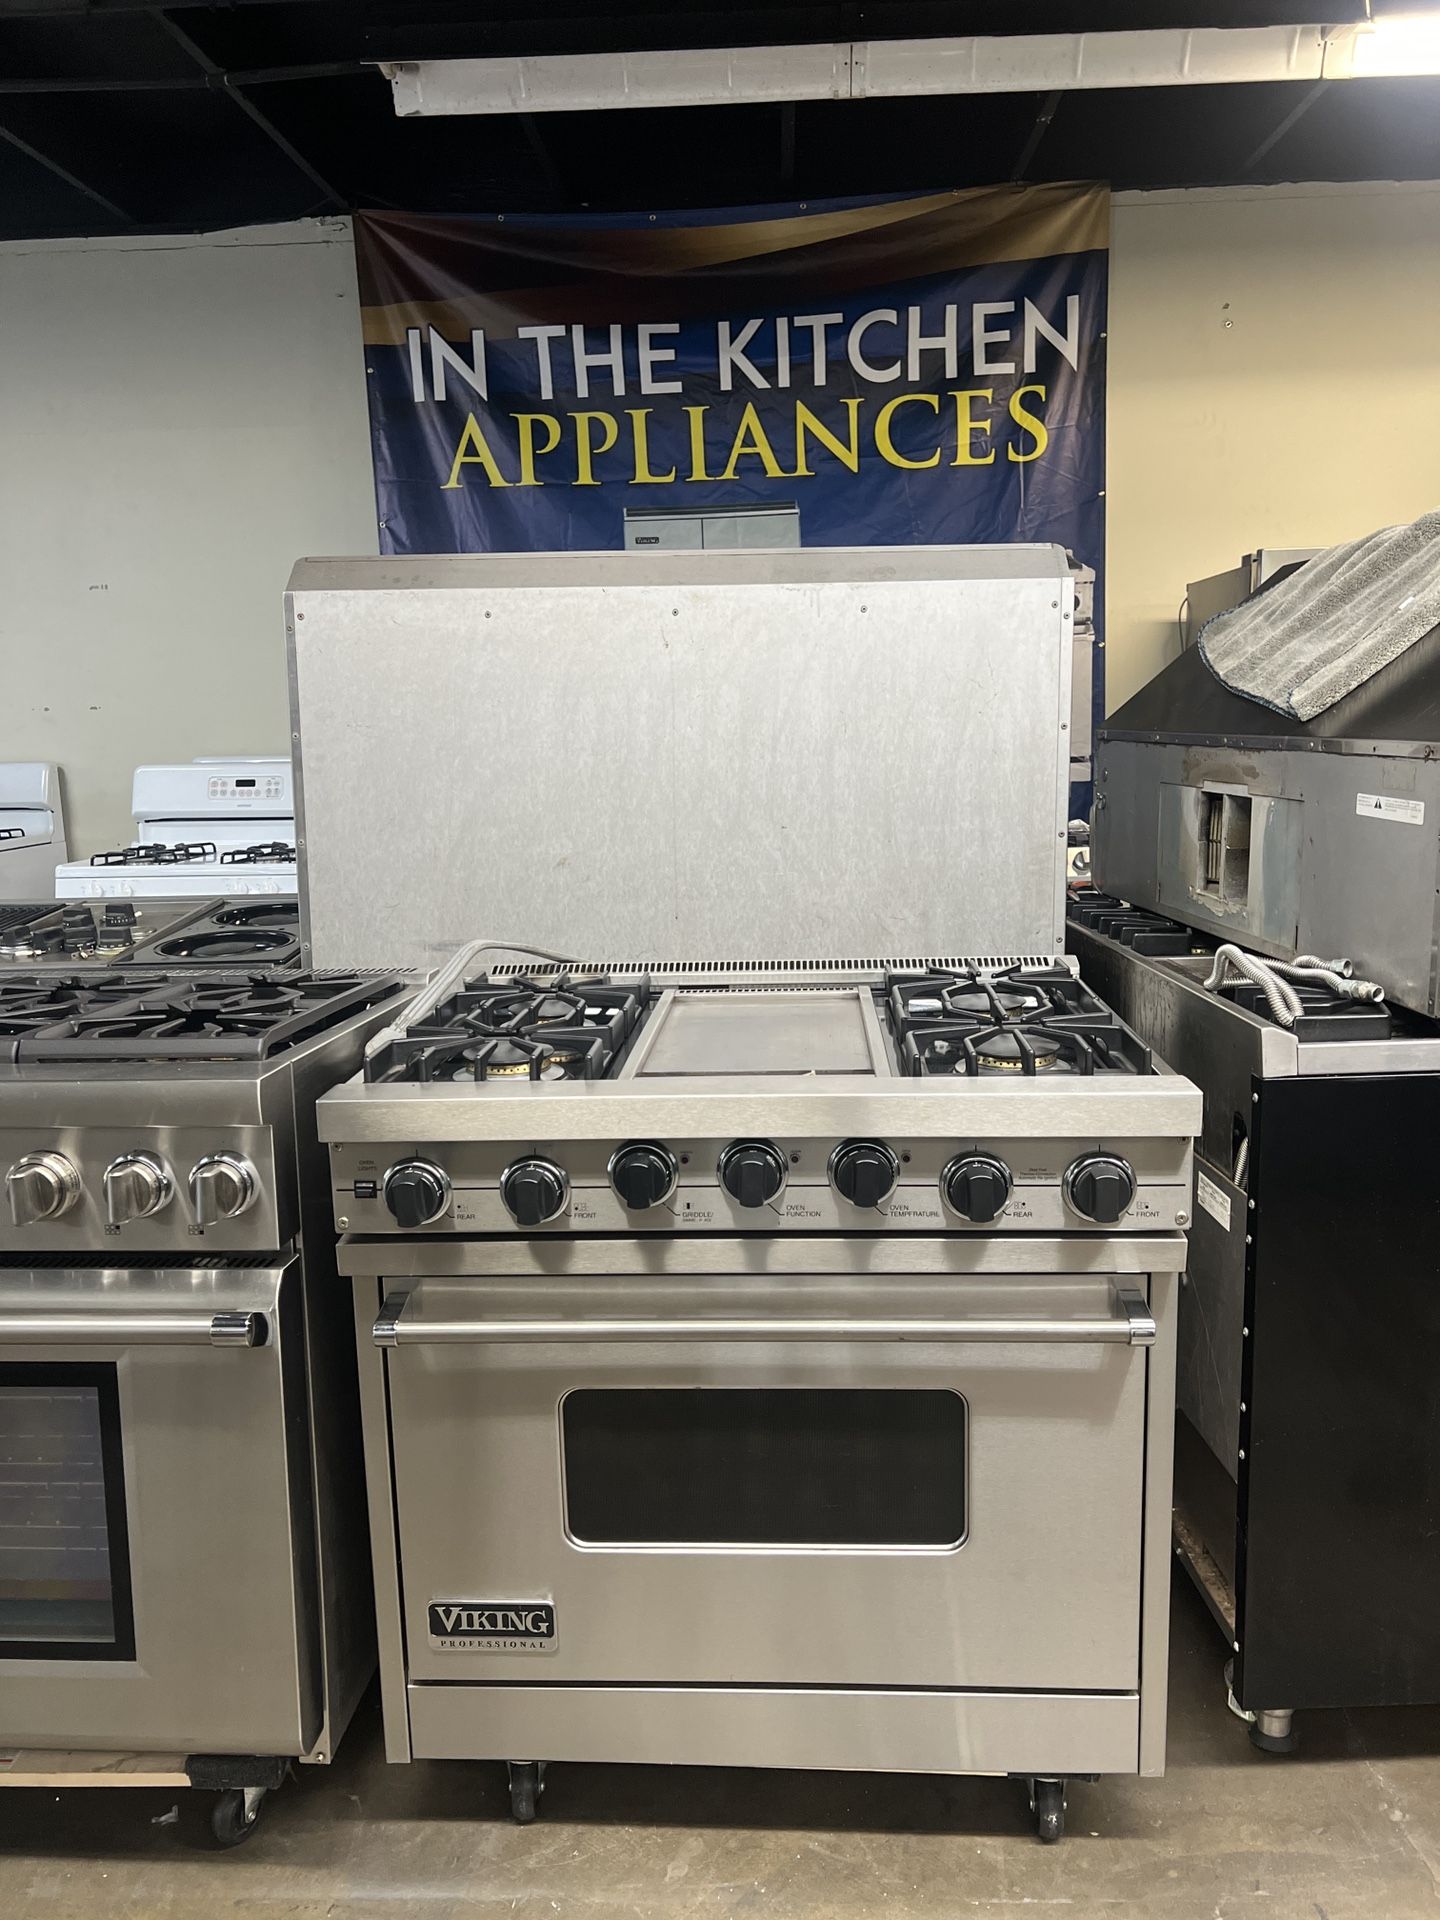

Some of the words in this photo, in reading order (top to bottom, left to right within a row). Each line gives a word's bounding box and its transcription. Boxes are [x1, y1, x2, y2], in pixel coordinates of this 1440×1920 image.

[407, 324, 489, 402] IN
[518, 323, 684, 400] THE
[717, 294, 1080, 391] KITCHEN
[440, 384, 1049, 490] APPLIANCES
[435, 1606, 549, 1634] VIKING
[440, 1640, 546, 1649] PROFESSIONAL
